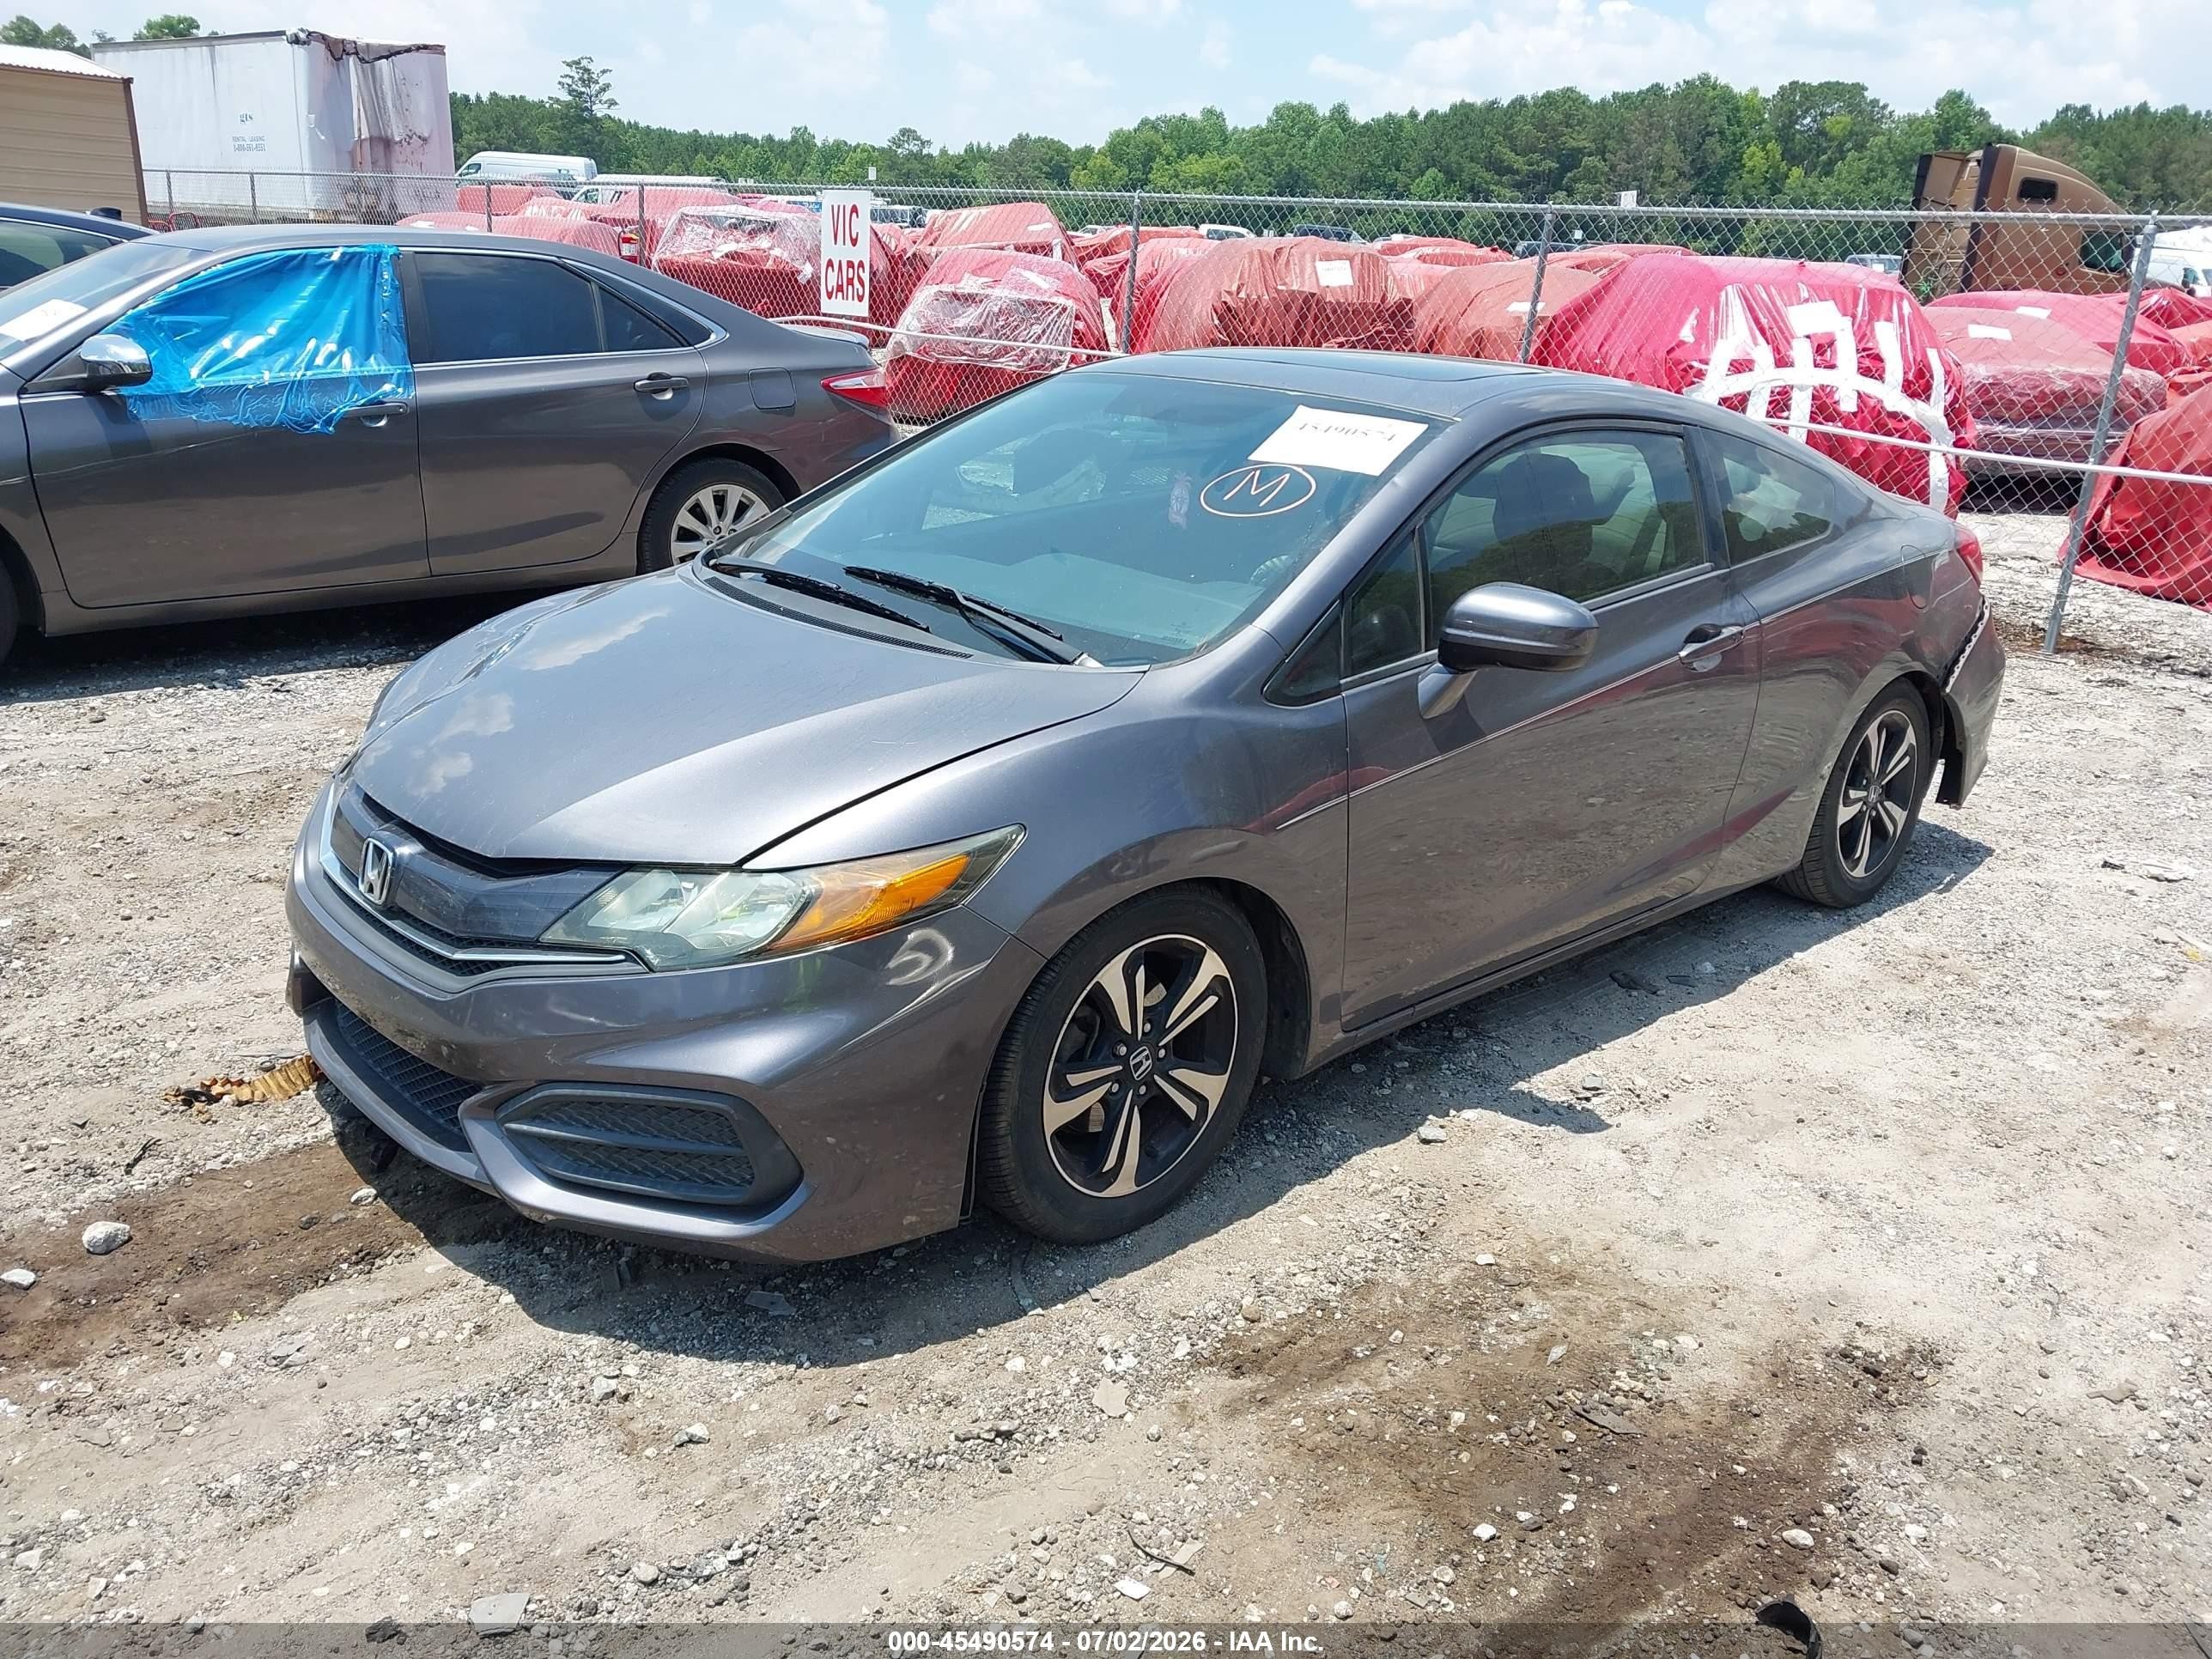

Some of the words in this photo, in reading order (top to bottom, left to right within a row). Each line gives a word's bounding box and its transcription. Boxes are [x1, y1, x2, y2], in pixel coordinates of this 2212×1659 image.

[830, 204, 860, 247] VIC
[824, 258, 866, 303] CARS
[1223, 470, 1291, 507] M
